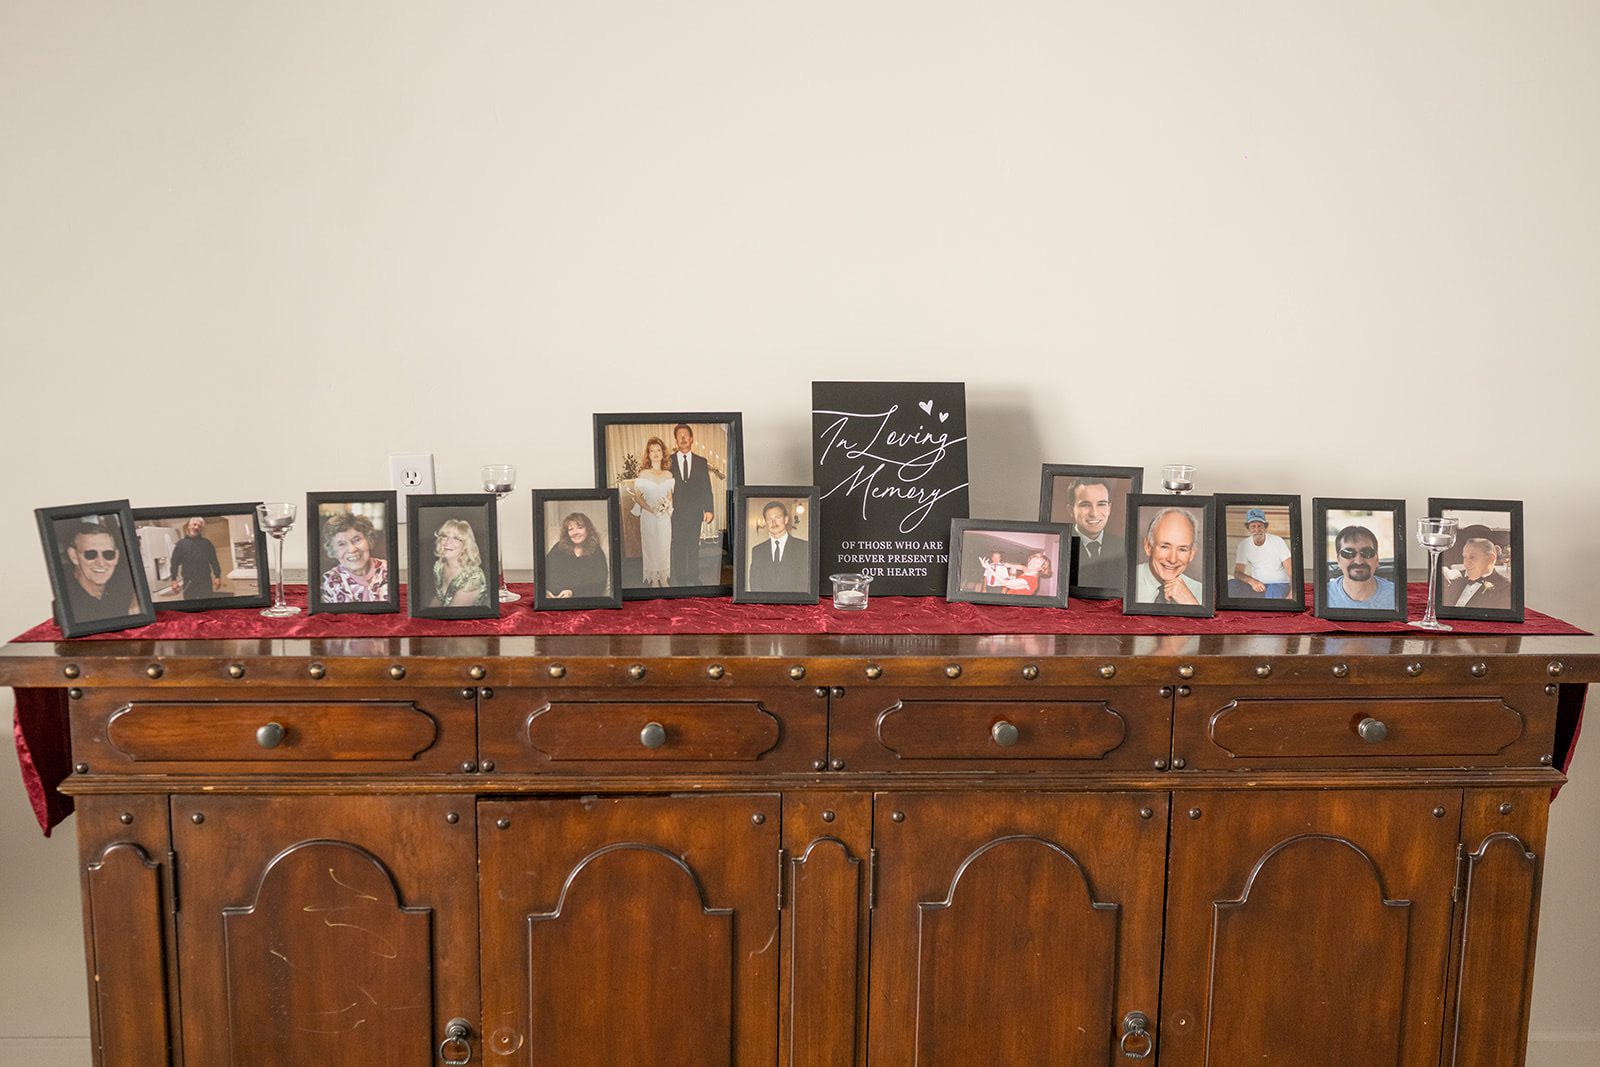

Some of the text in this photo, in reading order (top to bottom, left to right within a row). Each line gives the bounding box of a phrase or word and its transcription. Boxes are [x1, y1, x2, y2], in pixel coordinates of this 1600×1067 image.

[812, 404, 967, 482] In Loving
[819, 463, 969, 533] Memory
[841, 541, 943, 550] OF THOSE WHO ARE
[838, 554, 948, 563] FOREVER PRESENT IN
[862, 567, 927, 577] OUR HEARTS
